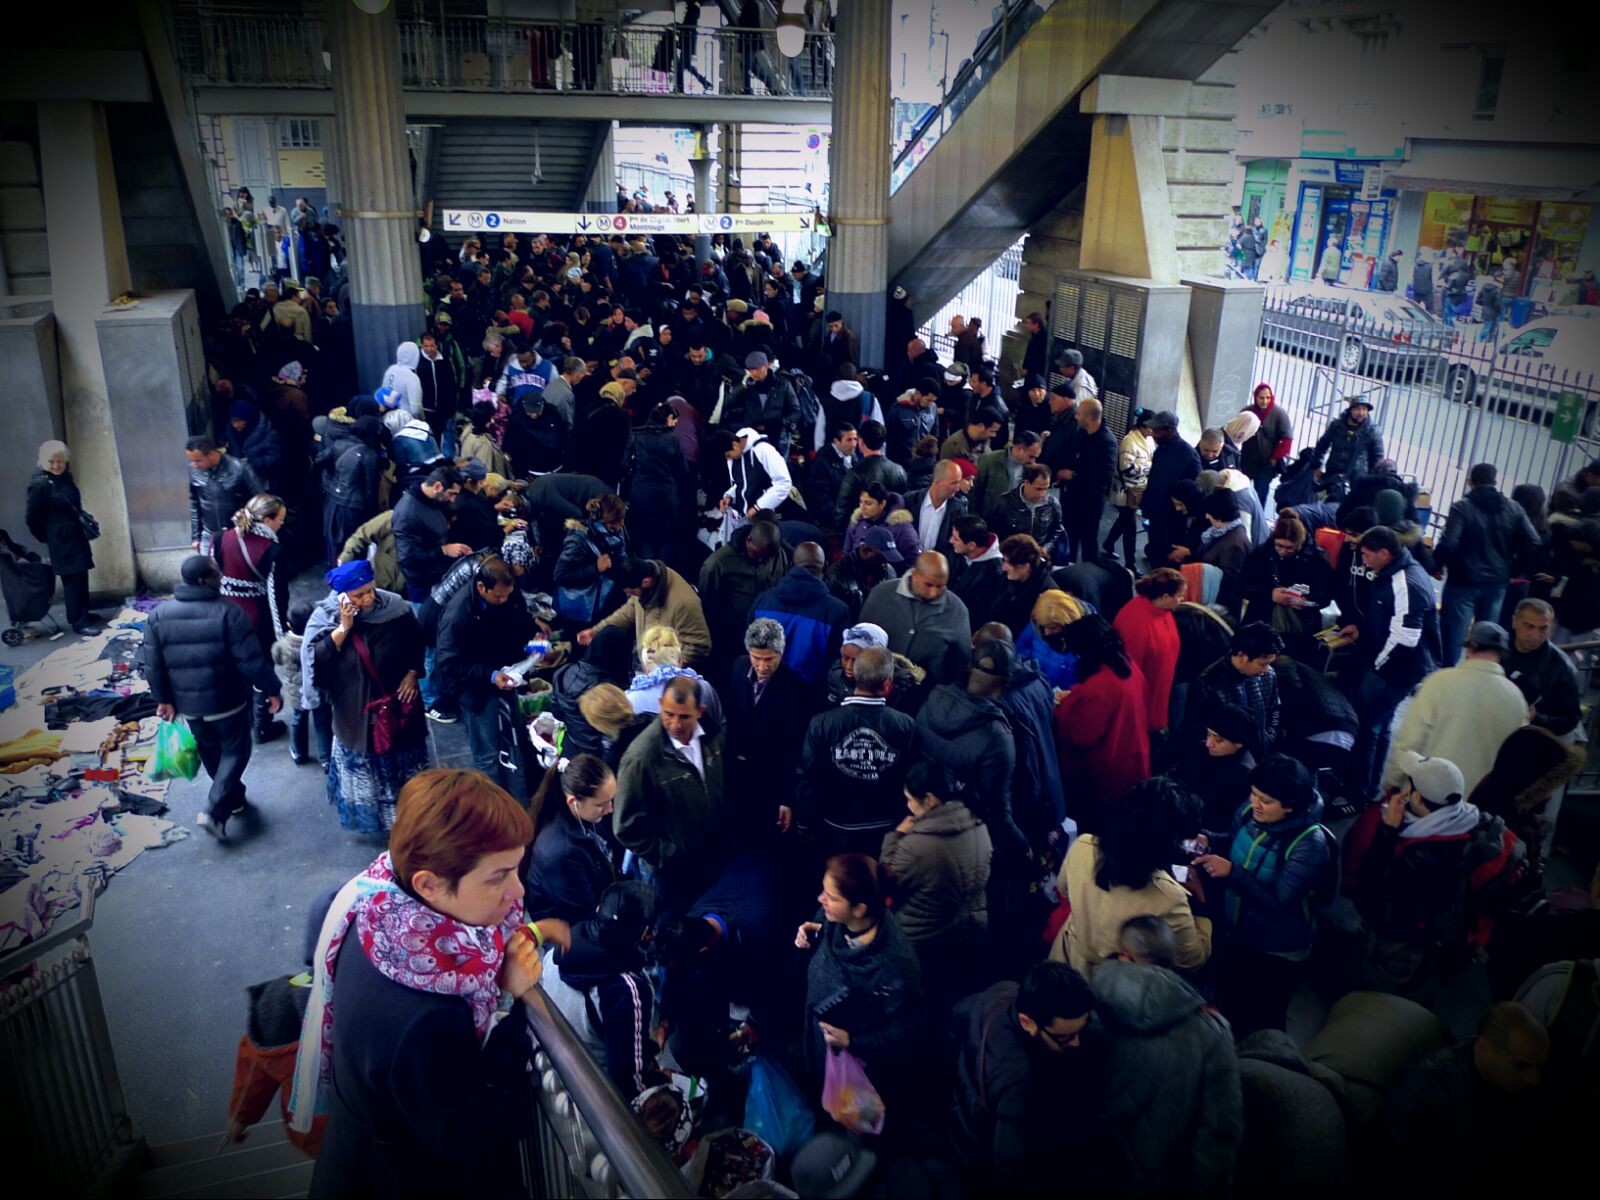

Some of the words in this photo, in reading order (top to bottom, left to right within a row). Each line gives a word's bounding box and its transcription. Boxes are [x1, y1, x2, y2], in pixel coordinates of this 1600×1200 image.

[503, 217, 527, 225] Nation
[745, 218, 774, 227] Dauphine
[629, 223, 665, 232] Montrouge
